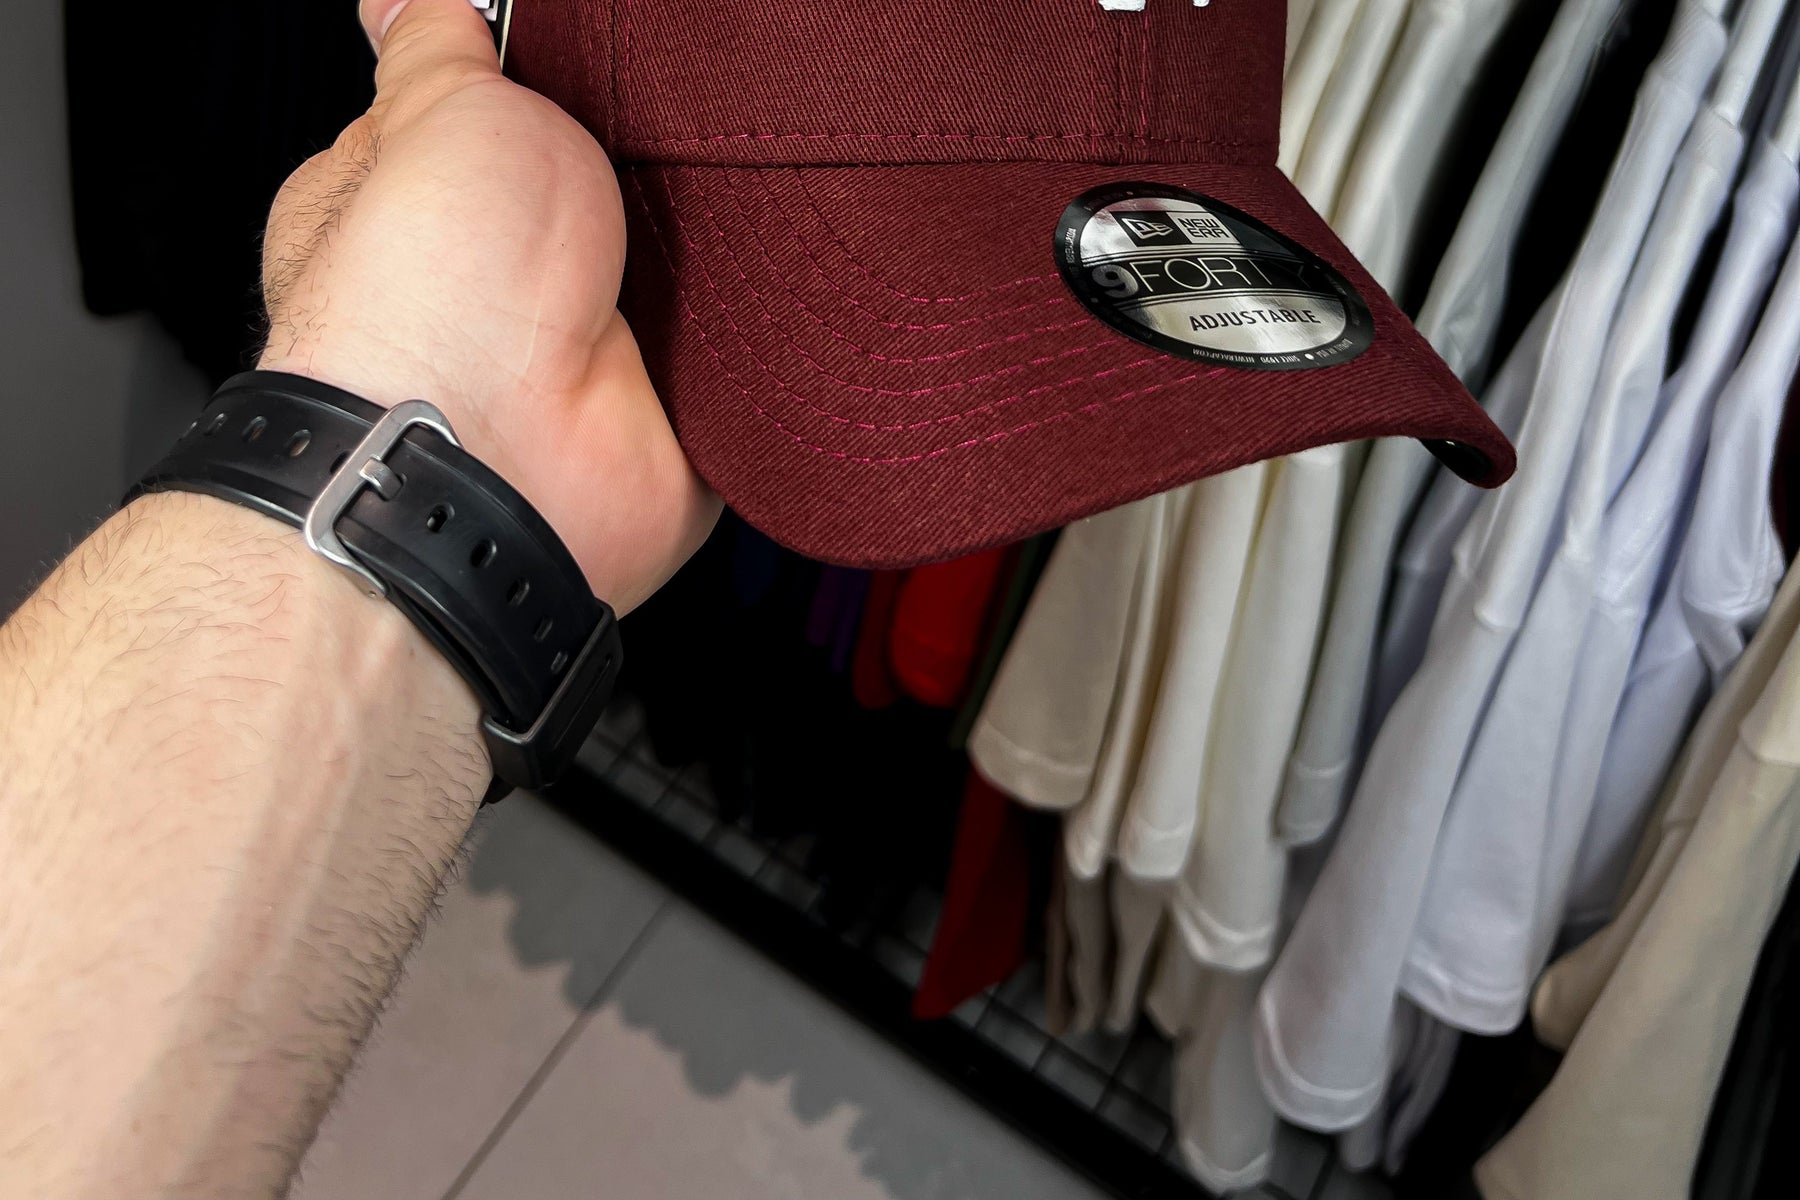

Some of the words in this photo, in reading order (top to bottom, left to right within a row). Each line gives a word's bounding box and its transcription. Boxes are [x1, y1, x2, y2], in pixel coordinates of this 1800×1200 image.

[1177, 218, 1221, 229] NEW
[1188, 227, 1230, 239] ERA
[1189, 309, 1322, 332] ADJUSTABLE
